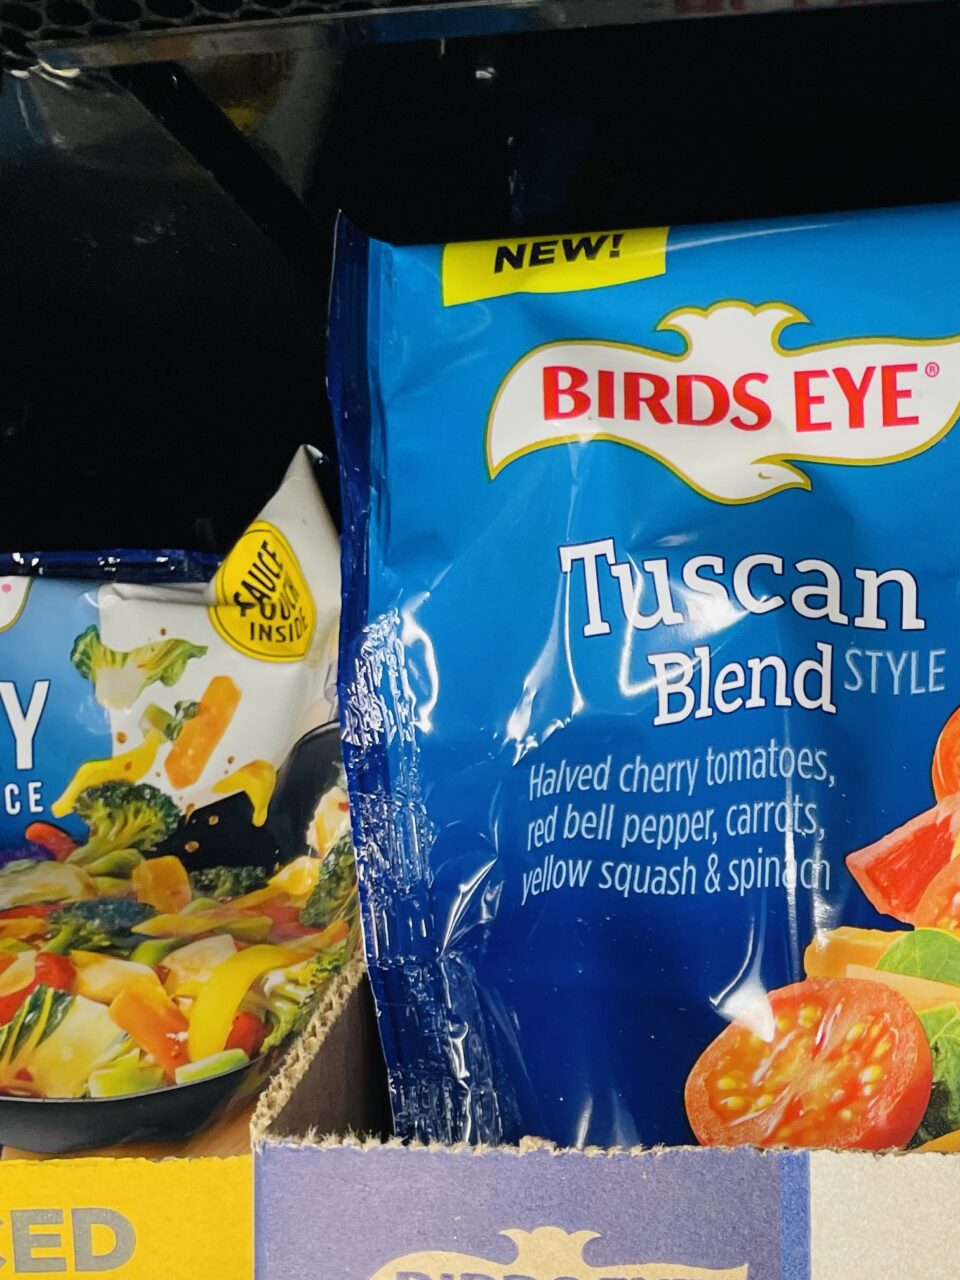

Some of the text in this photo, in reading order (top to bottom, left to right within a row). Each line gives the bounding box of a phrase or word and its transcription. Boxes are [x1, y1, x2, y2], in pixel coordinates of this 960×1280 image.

[493, 233, 624, 274] NEW!
[542, 364, 773, 432] BIRDS
[558, 537, 926, 638] Tuscan
[647, 642, 946, 727] Blend STYLE
[529, 737, 837, 801] Halved cherry tomatoes,
[527, 794, 826, 851] red bell pepper, carrots,
[521, 854, 593, 906] yellow
[598, 856, 697, 898] squash
[704, 853, 721, 894] &
[0, 1207, 137, 1273] ED
